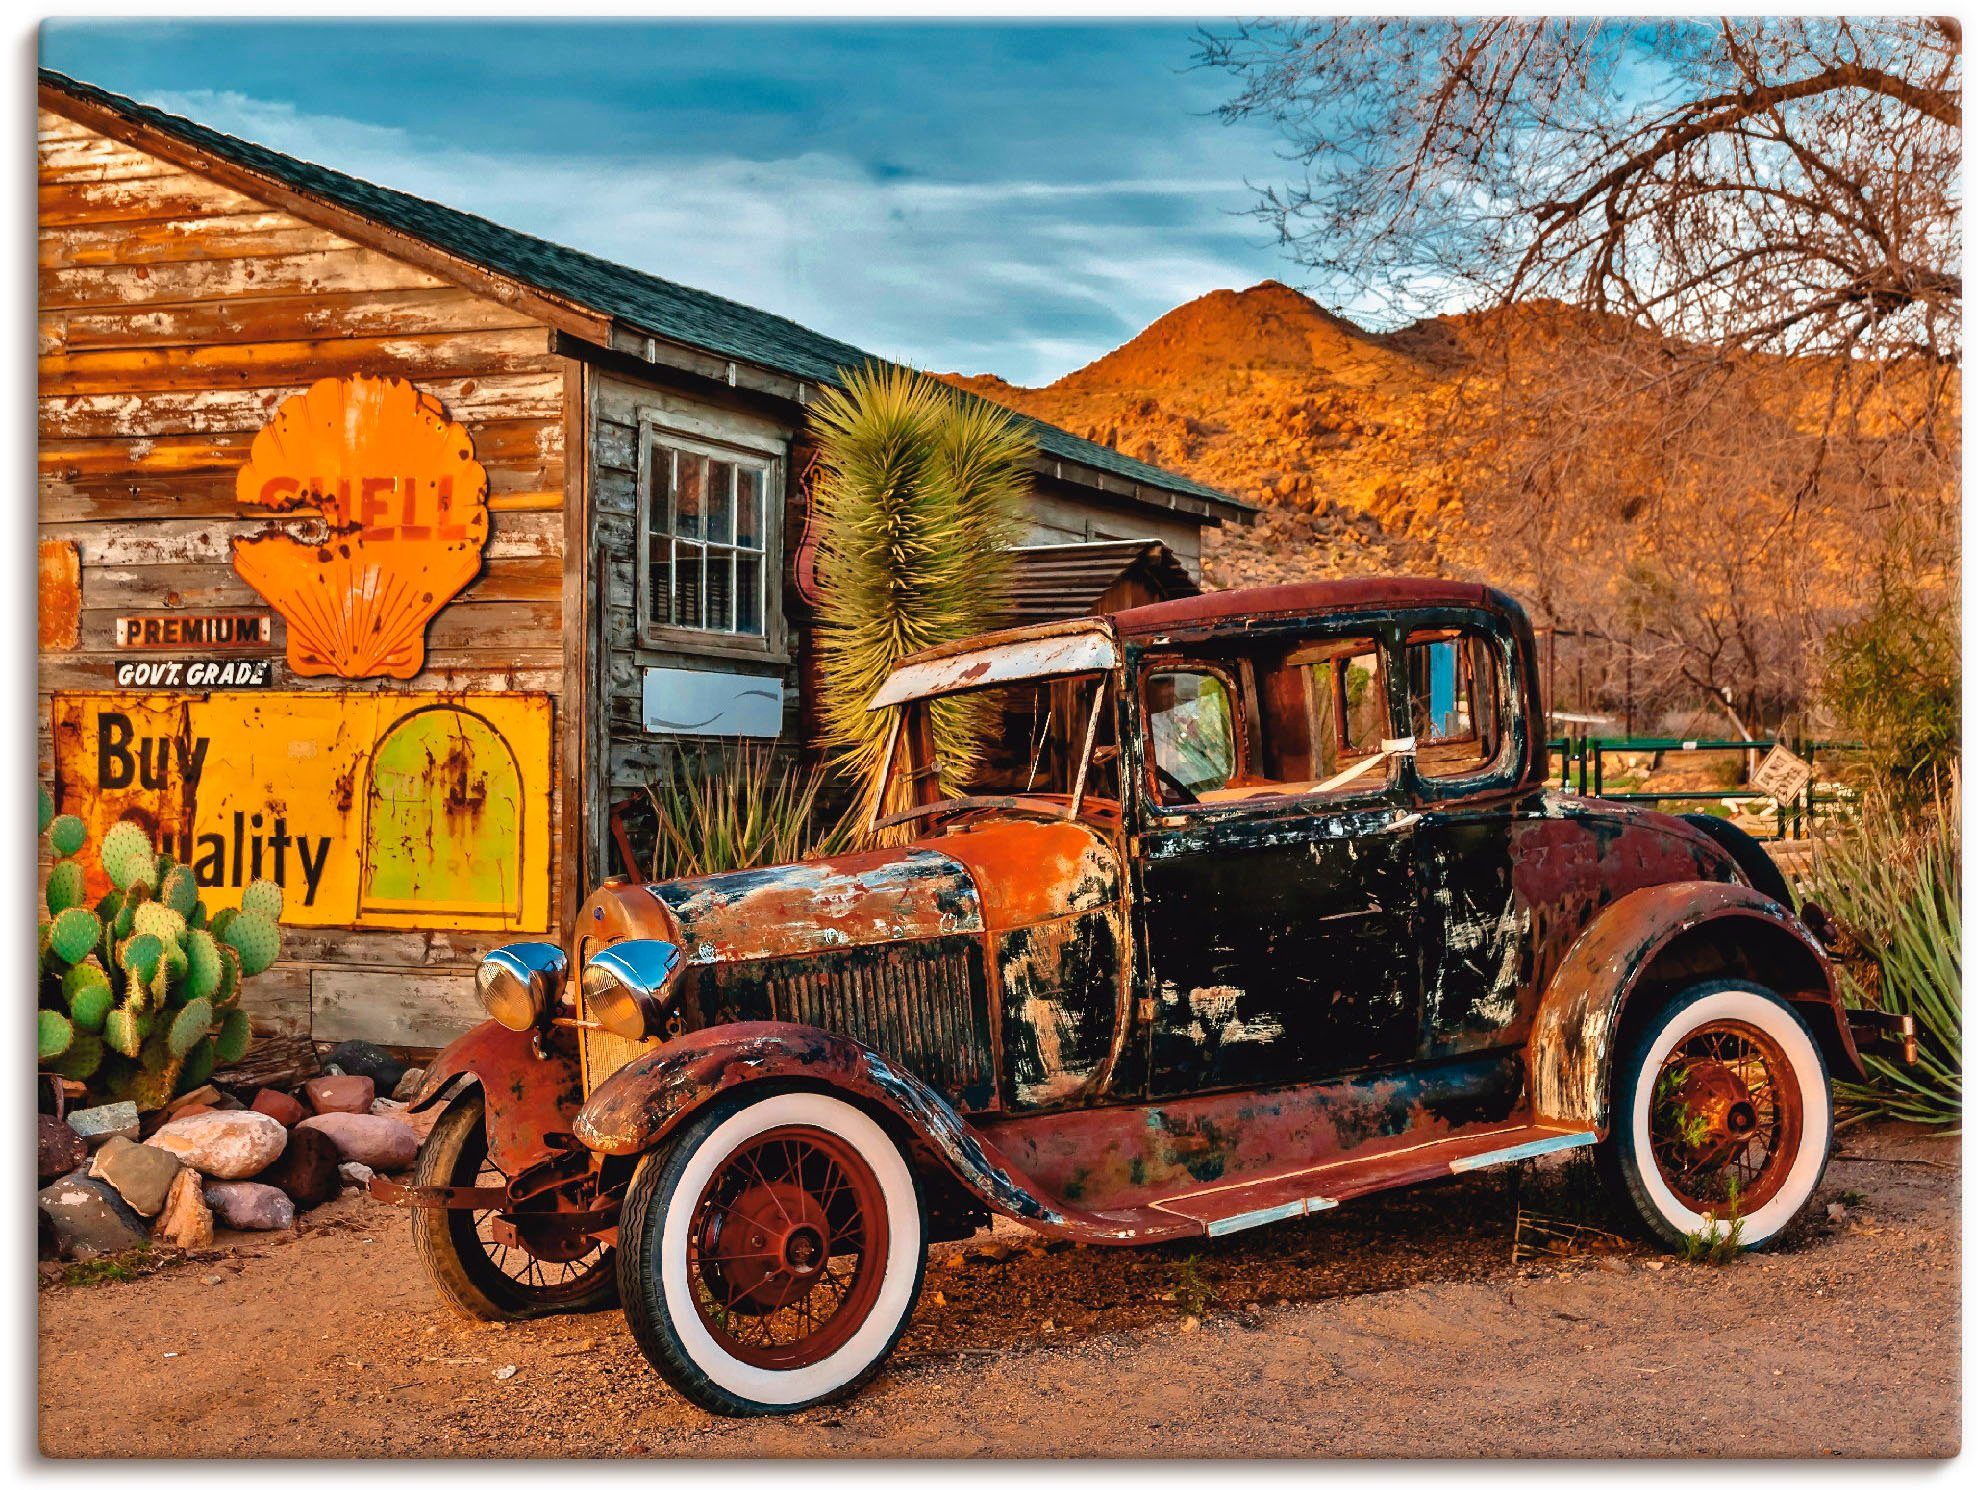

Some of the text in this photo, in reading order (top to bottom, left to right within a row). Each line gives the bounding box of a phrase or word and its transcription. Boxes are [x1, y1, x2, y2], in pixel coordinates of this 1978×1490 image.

[127, 618, 260, 645] PREMIUM
[186, 662, 268, 686] GRADE
[98, 712, 210, 802] Buy
